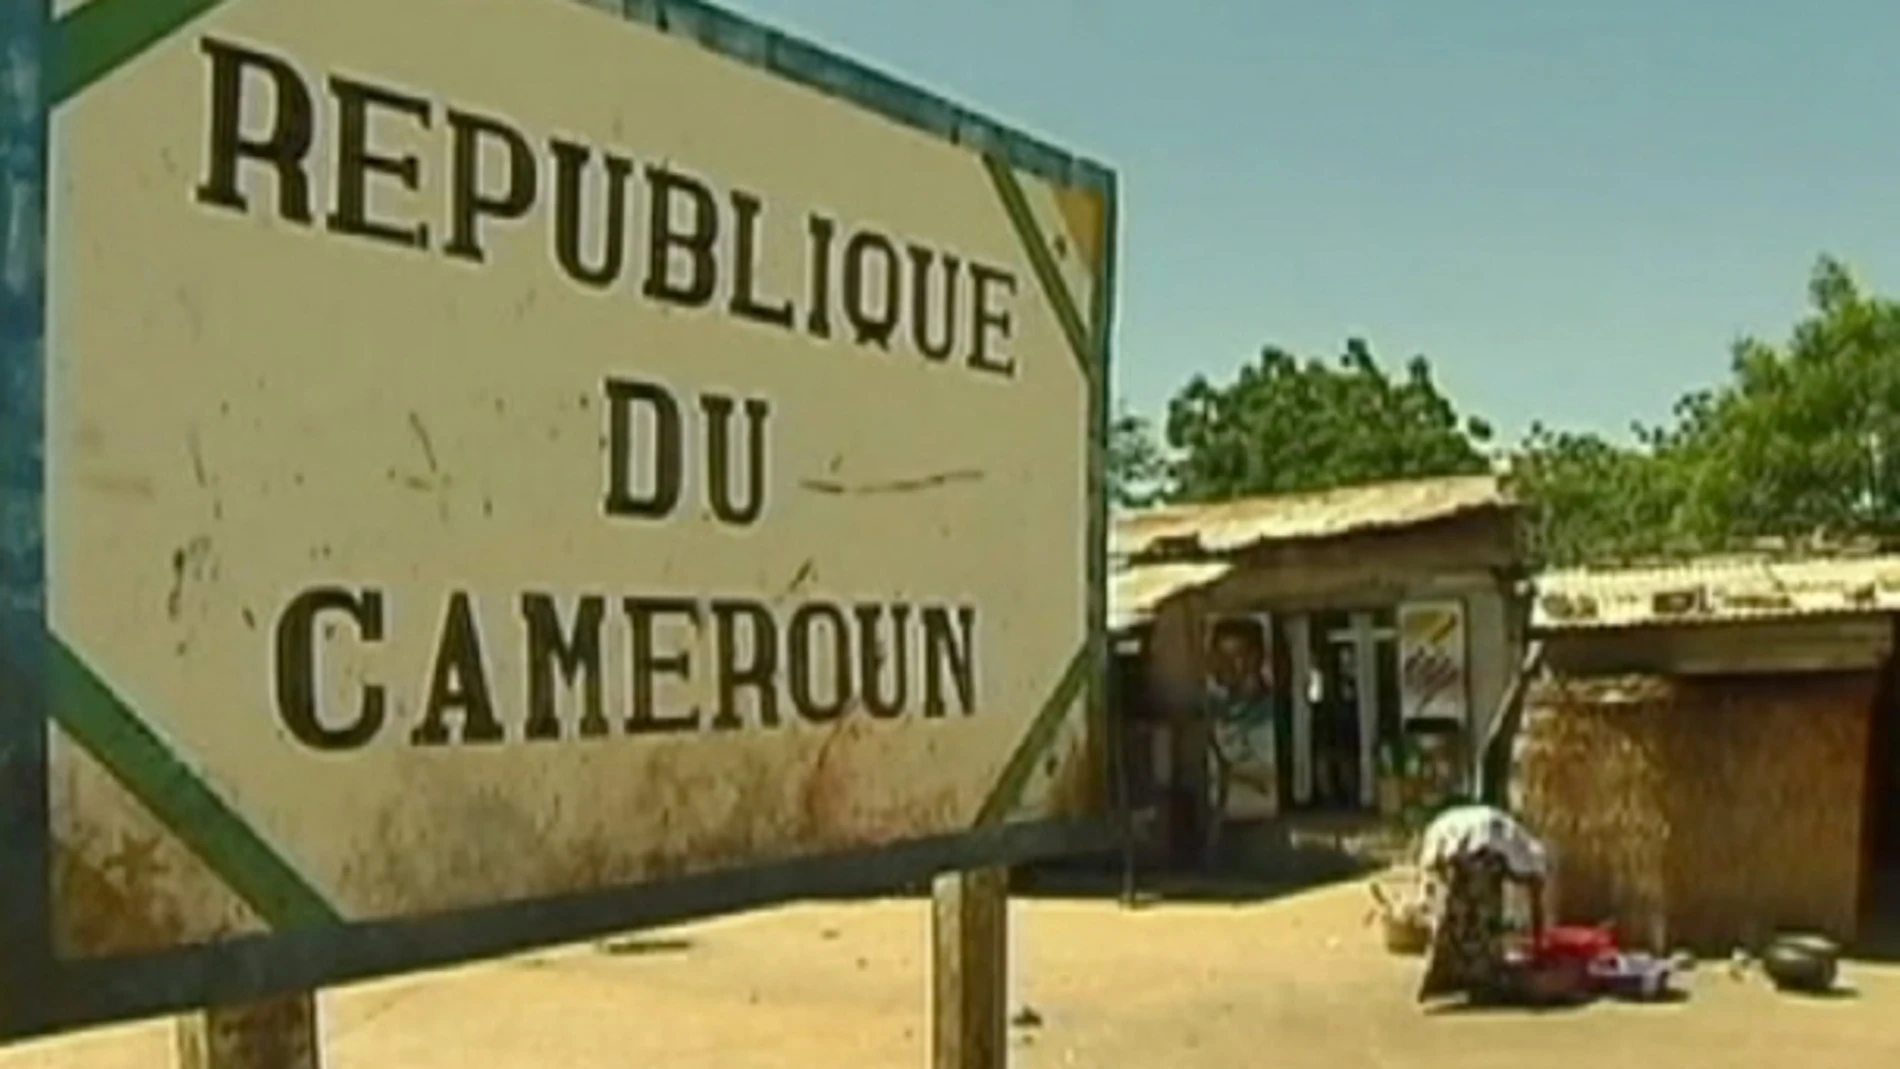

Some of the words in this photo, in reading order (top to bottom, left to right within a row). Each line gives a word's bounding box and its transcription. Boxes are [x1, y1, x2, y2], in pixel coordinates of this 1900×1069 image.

[195, 36, 1017, 377] REPUBLIQUE
[603, 379, 769, 525] DU
[274, 588, 976, 750] CAMEROUN
